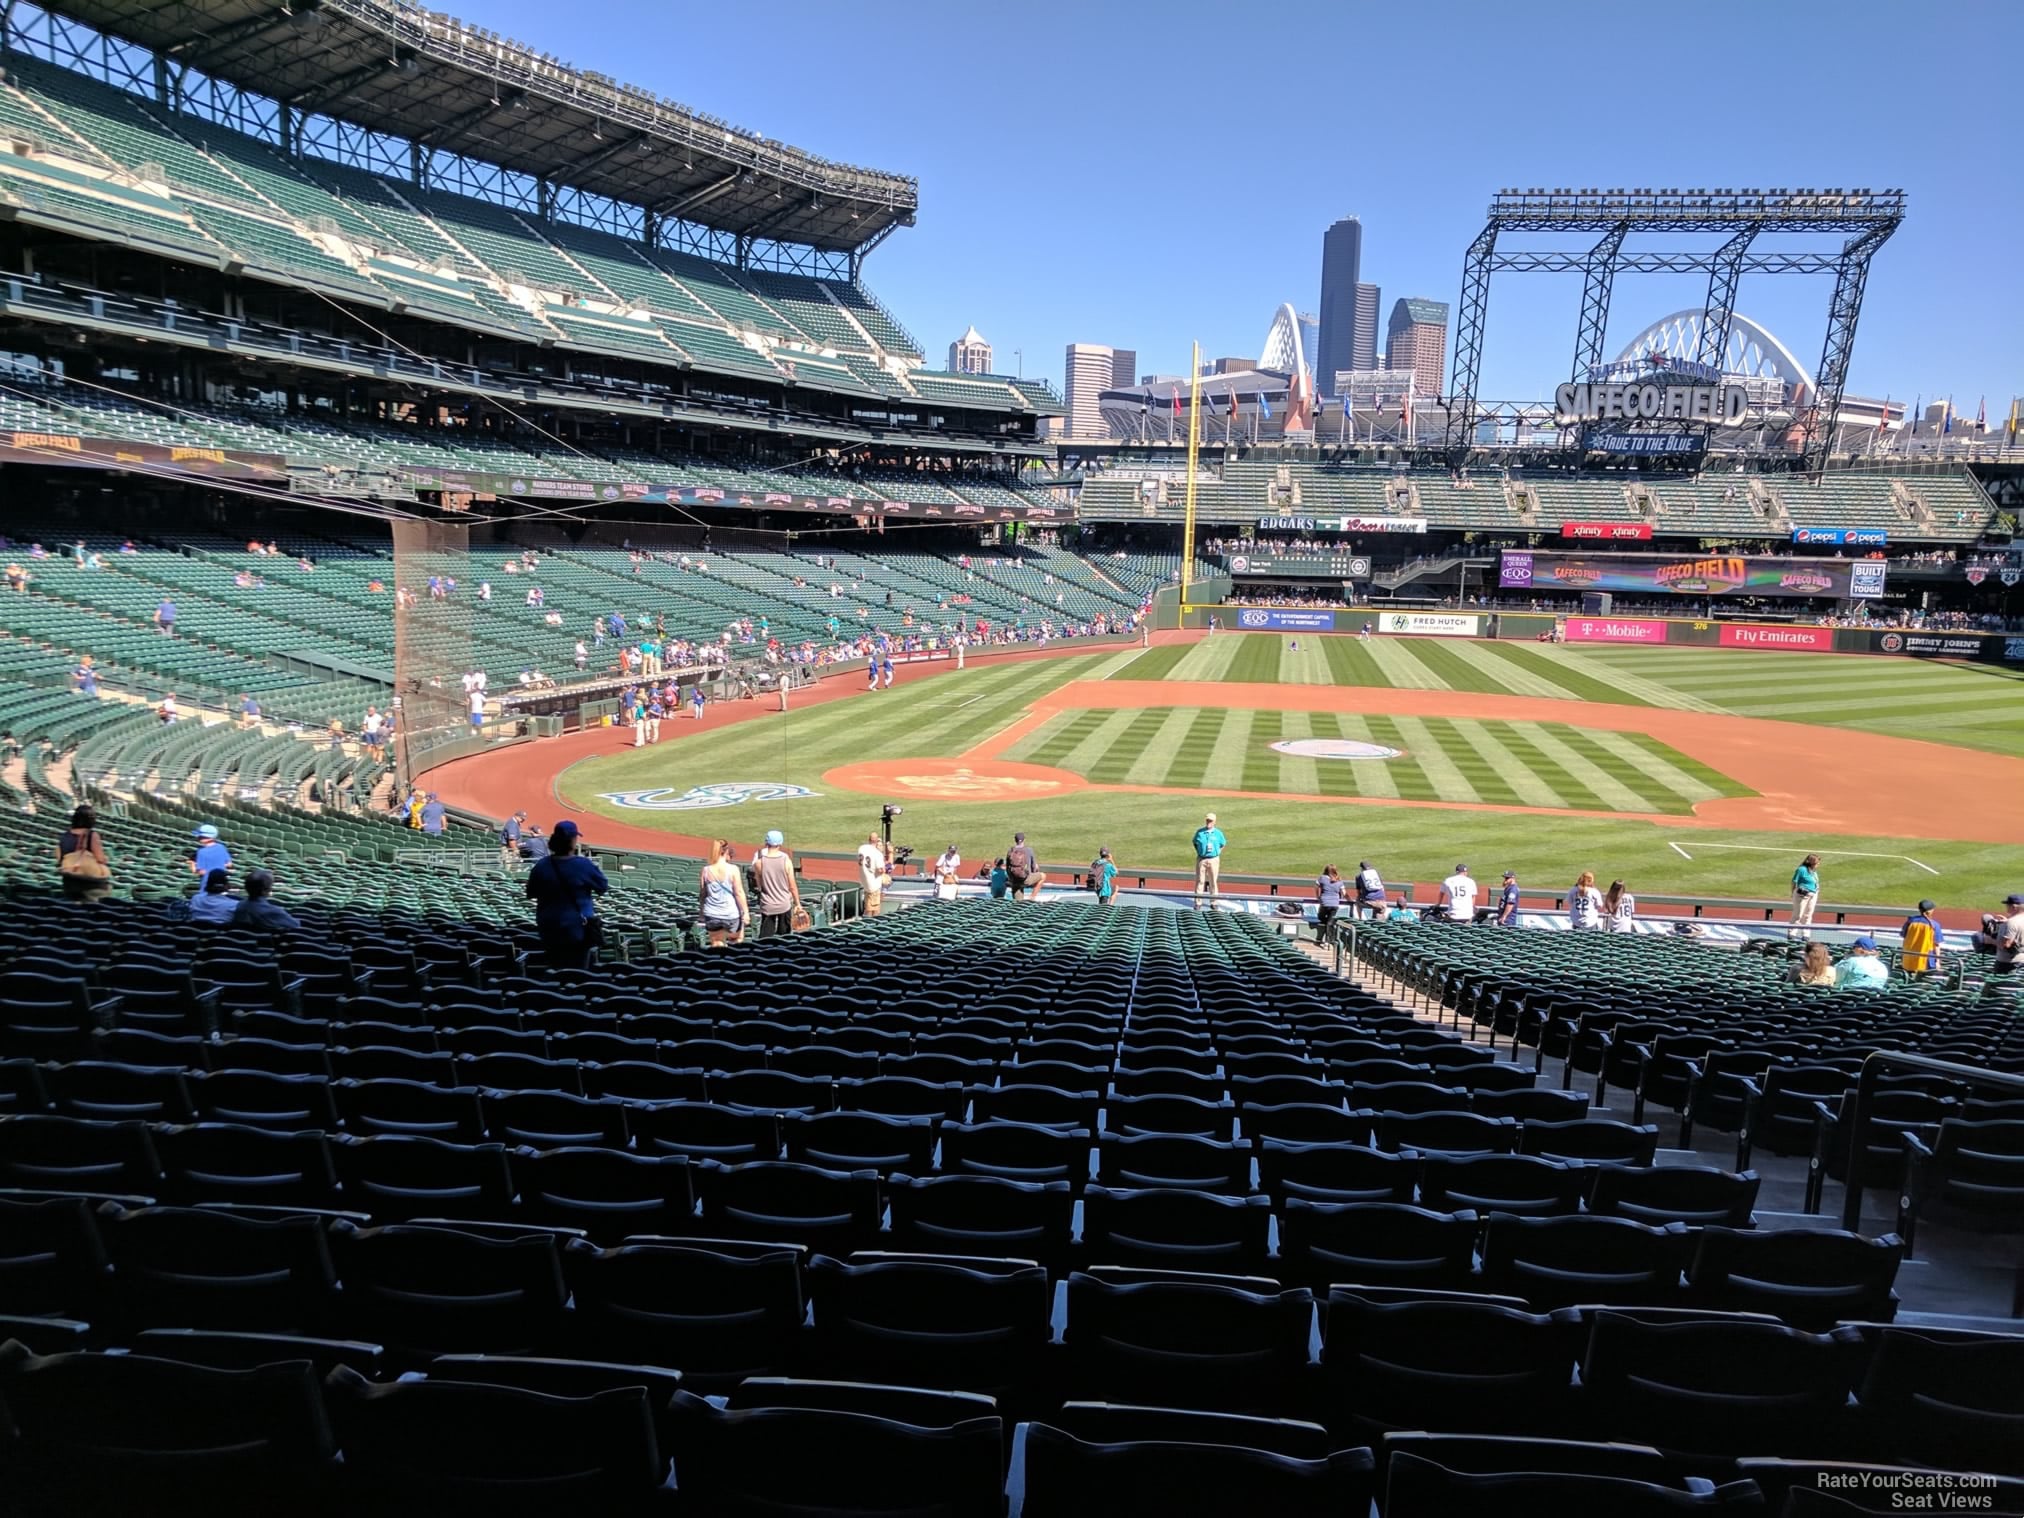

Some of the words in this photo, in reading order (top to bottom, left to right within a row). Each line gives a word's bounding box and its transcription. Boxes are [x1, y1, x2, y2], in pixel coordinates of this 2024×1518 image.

[1670, 356, 1721, 381] MARINERS
[1555, 382, 1661, 427] SAFECO
[1663, 384, 1749, 428] FIELD
[1604, 434, 1630, 450] TRUE
[1630, 437, 1647, 451] TO
[1645, 437, 1667, 451] THE
[1665, 435, 1694, 452] BLUE
[1574, 526, 1603, 537] xfinity
[1612, 527, 1641, 538] xfinity
[1811, 531, 1838, 542] pepsi
[1858, 533, 1885, 543] pepsi
[1506, 568, 1530, 580] EQC
[1695, 558, 1746, 586] FIELD
[1855, 566, 1882, 576] BUILT
[1780, 574, 1812, 587] SAFECO
[1812, 576, 1833, 588] FIELD
[1854, 585, 1881, 594] TOUGH
[1414, 617, 1436, 625] FRED
[1693, 622, 1708, 631] 376
[1735, 629, 1757, 643] Fly
[1759, 630, 1816, 644] Emirates
[1906, 638, 1942, 647] JIMMY
[1943, 640, 1981, 649] JOHN'S
[1454, 886, 1467, 898] 15
[1575, 898, 1590, 911] 22
[1619, 904, 1631, 918] 18
